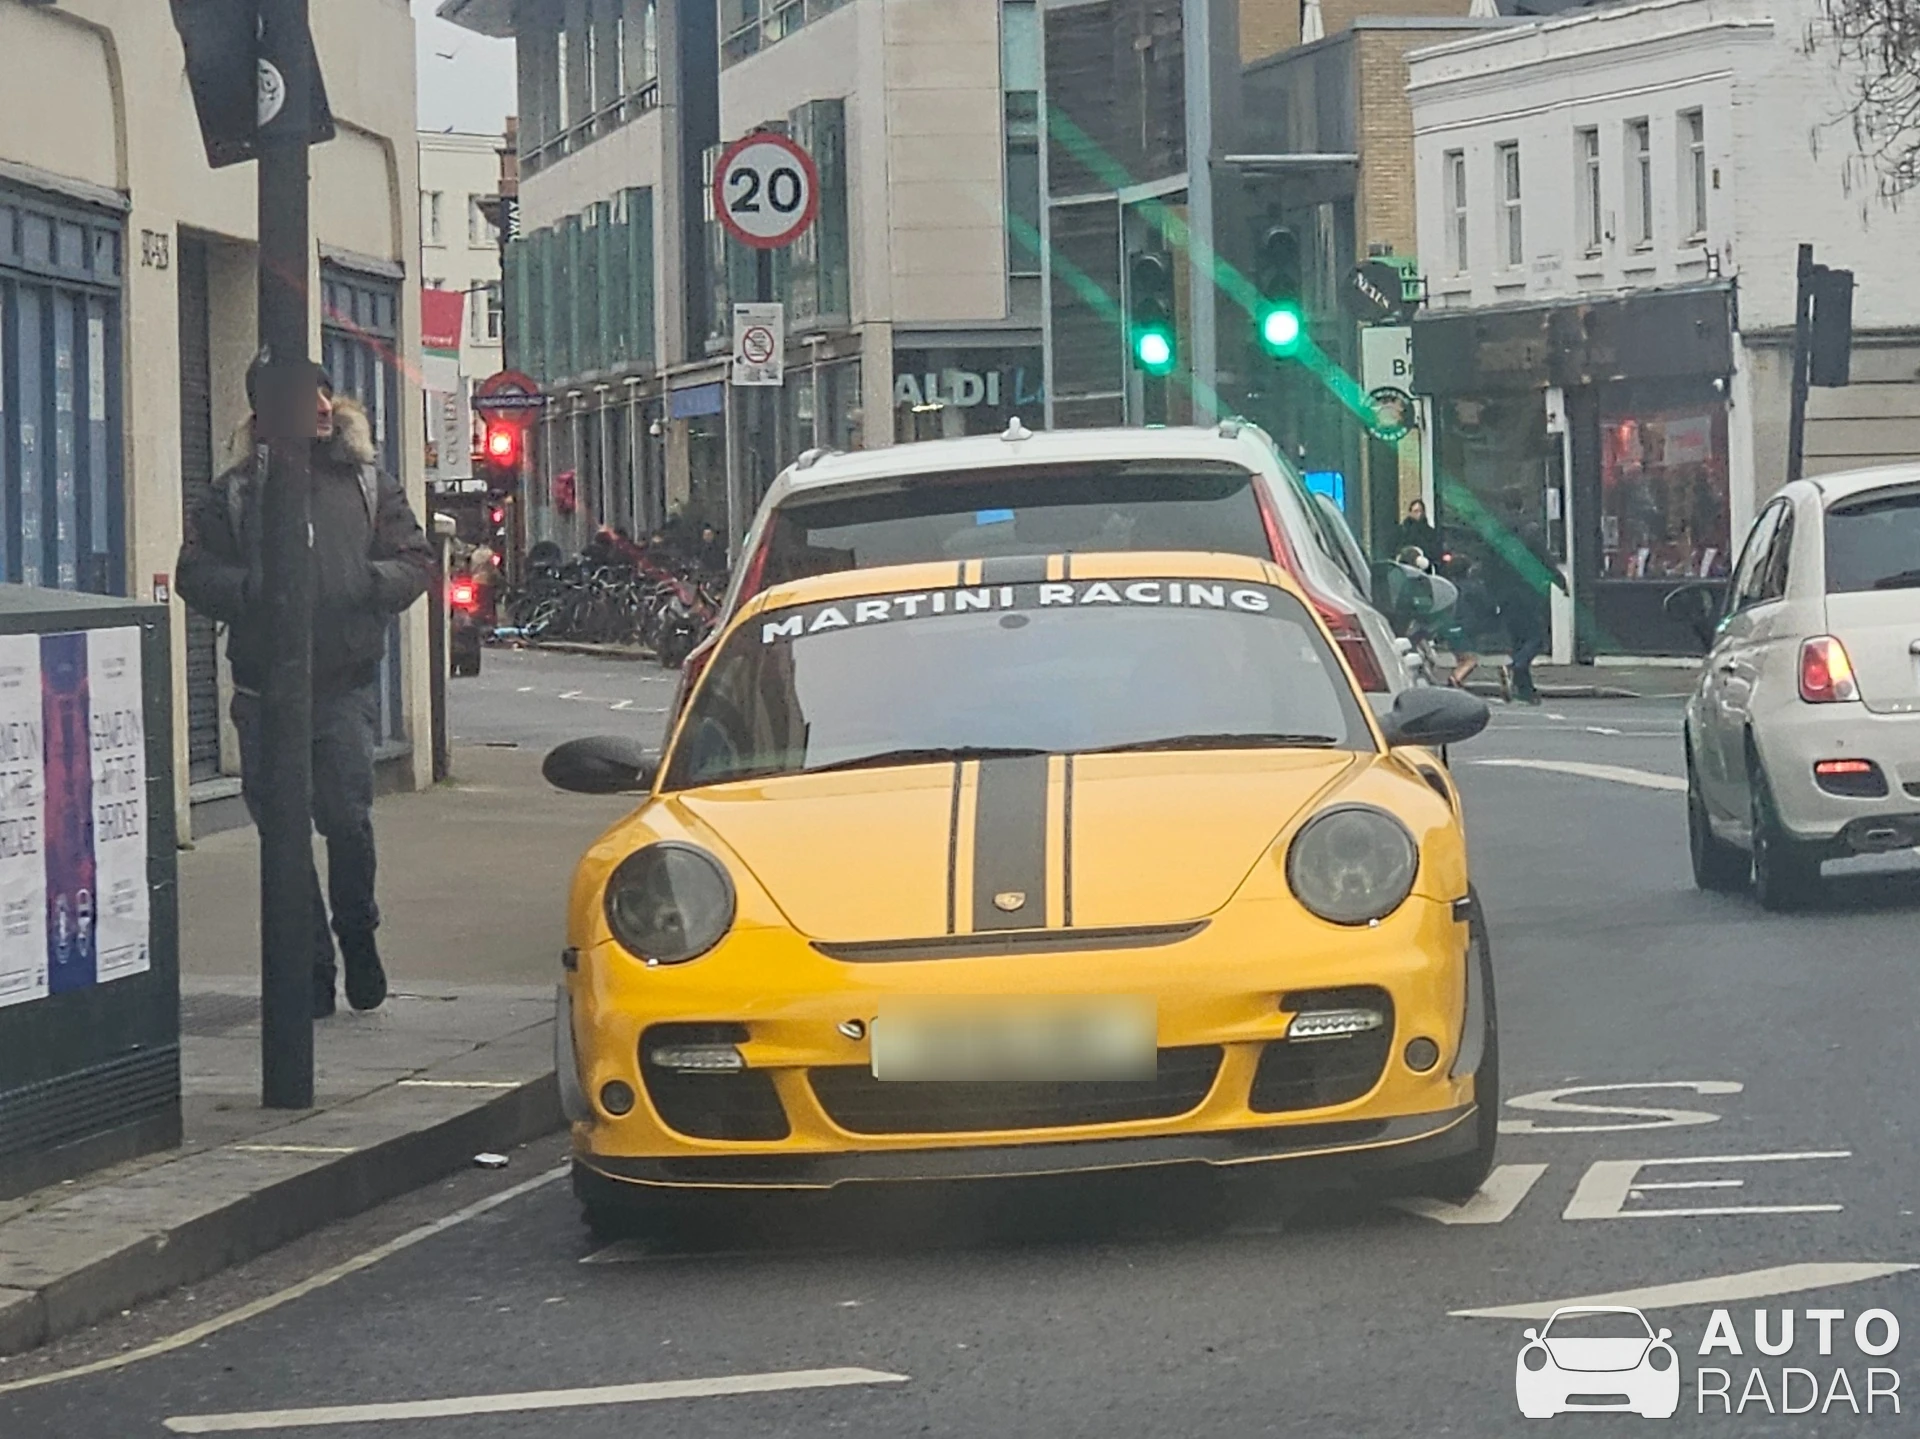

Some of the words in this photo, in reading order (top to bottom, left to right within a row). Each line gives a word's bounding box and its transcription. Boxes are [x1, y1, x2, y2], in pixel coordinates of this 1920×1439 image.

[729, 167, 803, 213] 20
[894, 371, 1000, 406] ALDI
[762, 586, 1013, 643] MARTINI
[1040, 581, 1270, 612] RACING
